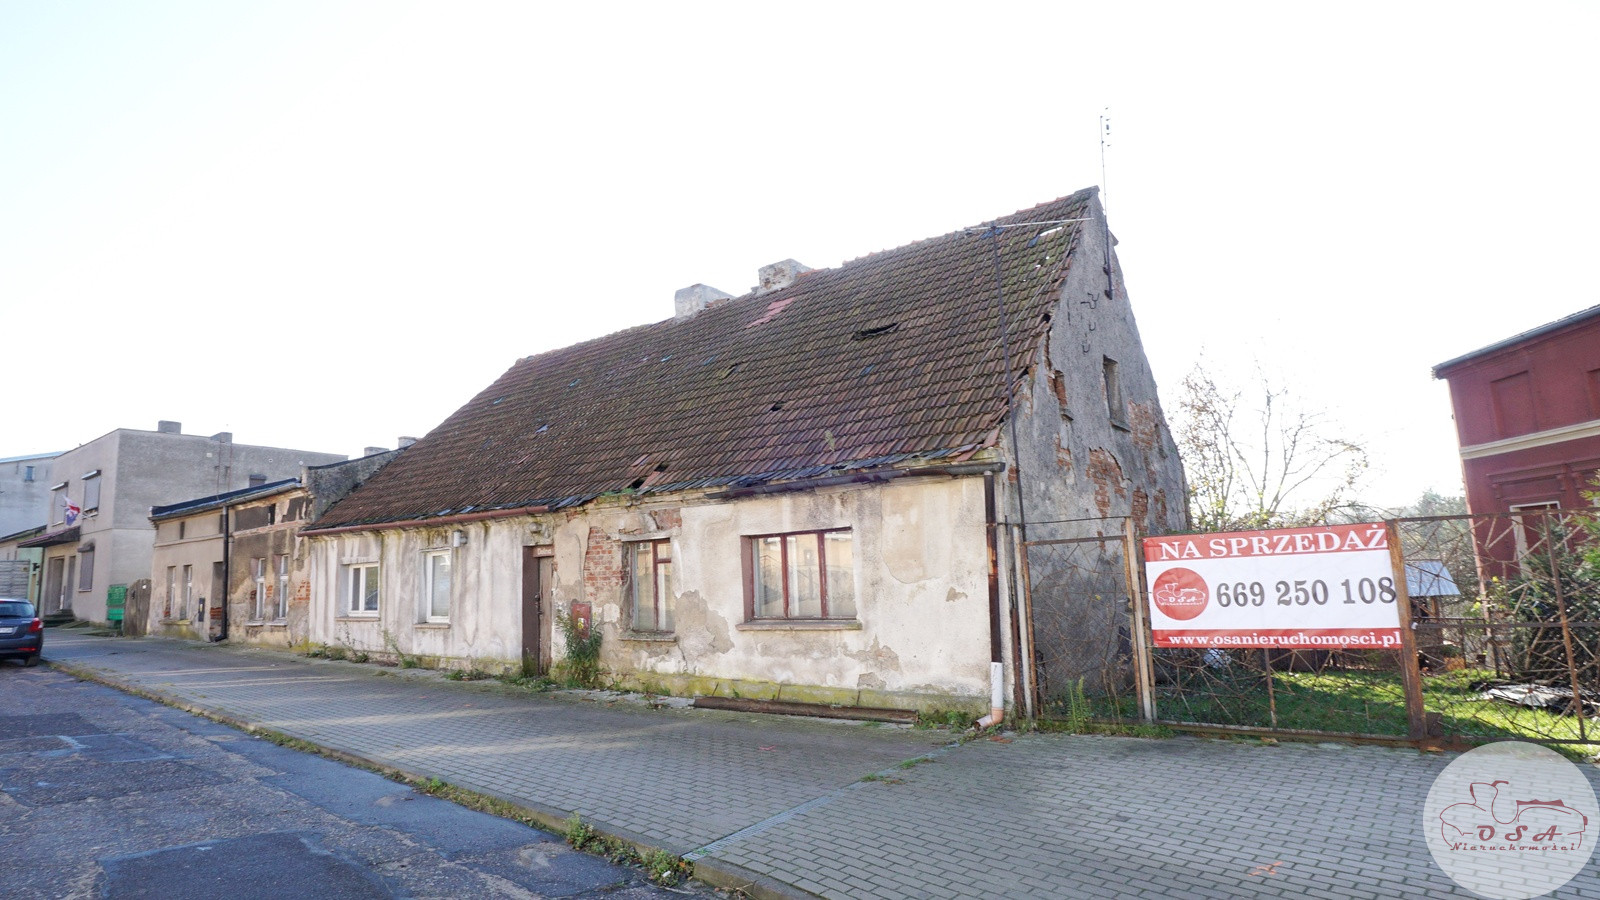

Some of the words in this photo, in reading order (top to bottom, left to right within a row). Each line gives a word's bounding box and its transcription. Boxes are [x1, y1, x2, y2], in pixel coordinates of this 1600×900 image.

[1159, 541, 1202, 560] NA
[1209, 524, 1388, 557] SPRZEDAŻ
[1216, 581, 1265, 607] 669
[1275, 579, 1329, 606] 250
[1341, 576, 1396, 604] 108
[1168, 631, 1402, 647] www.osanieruchomosci.pl
